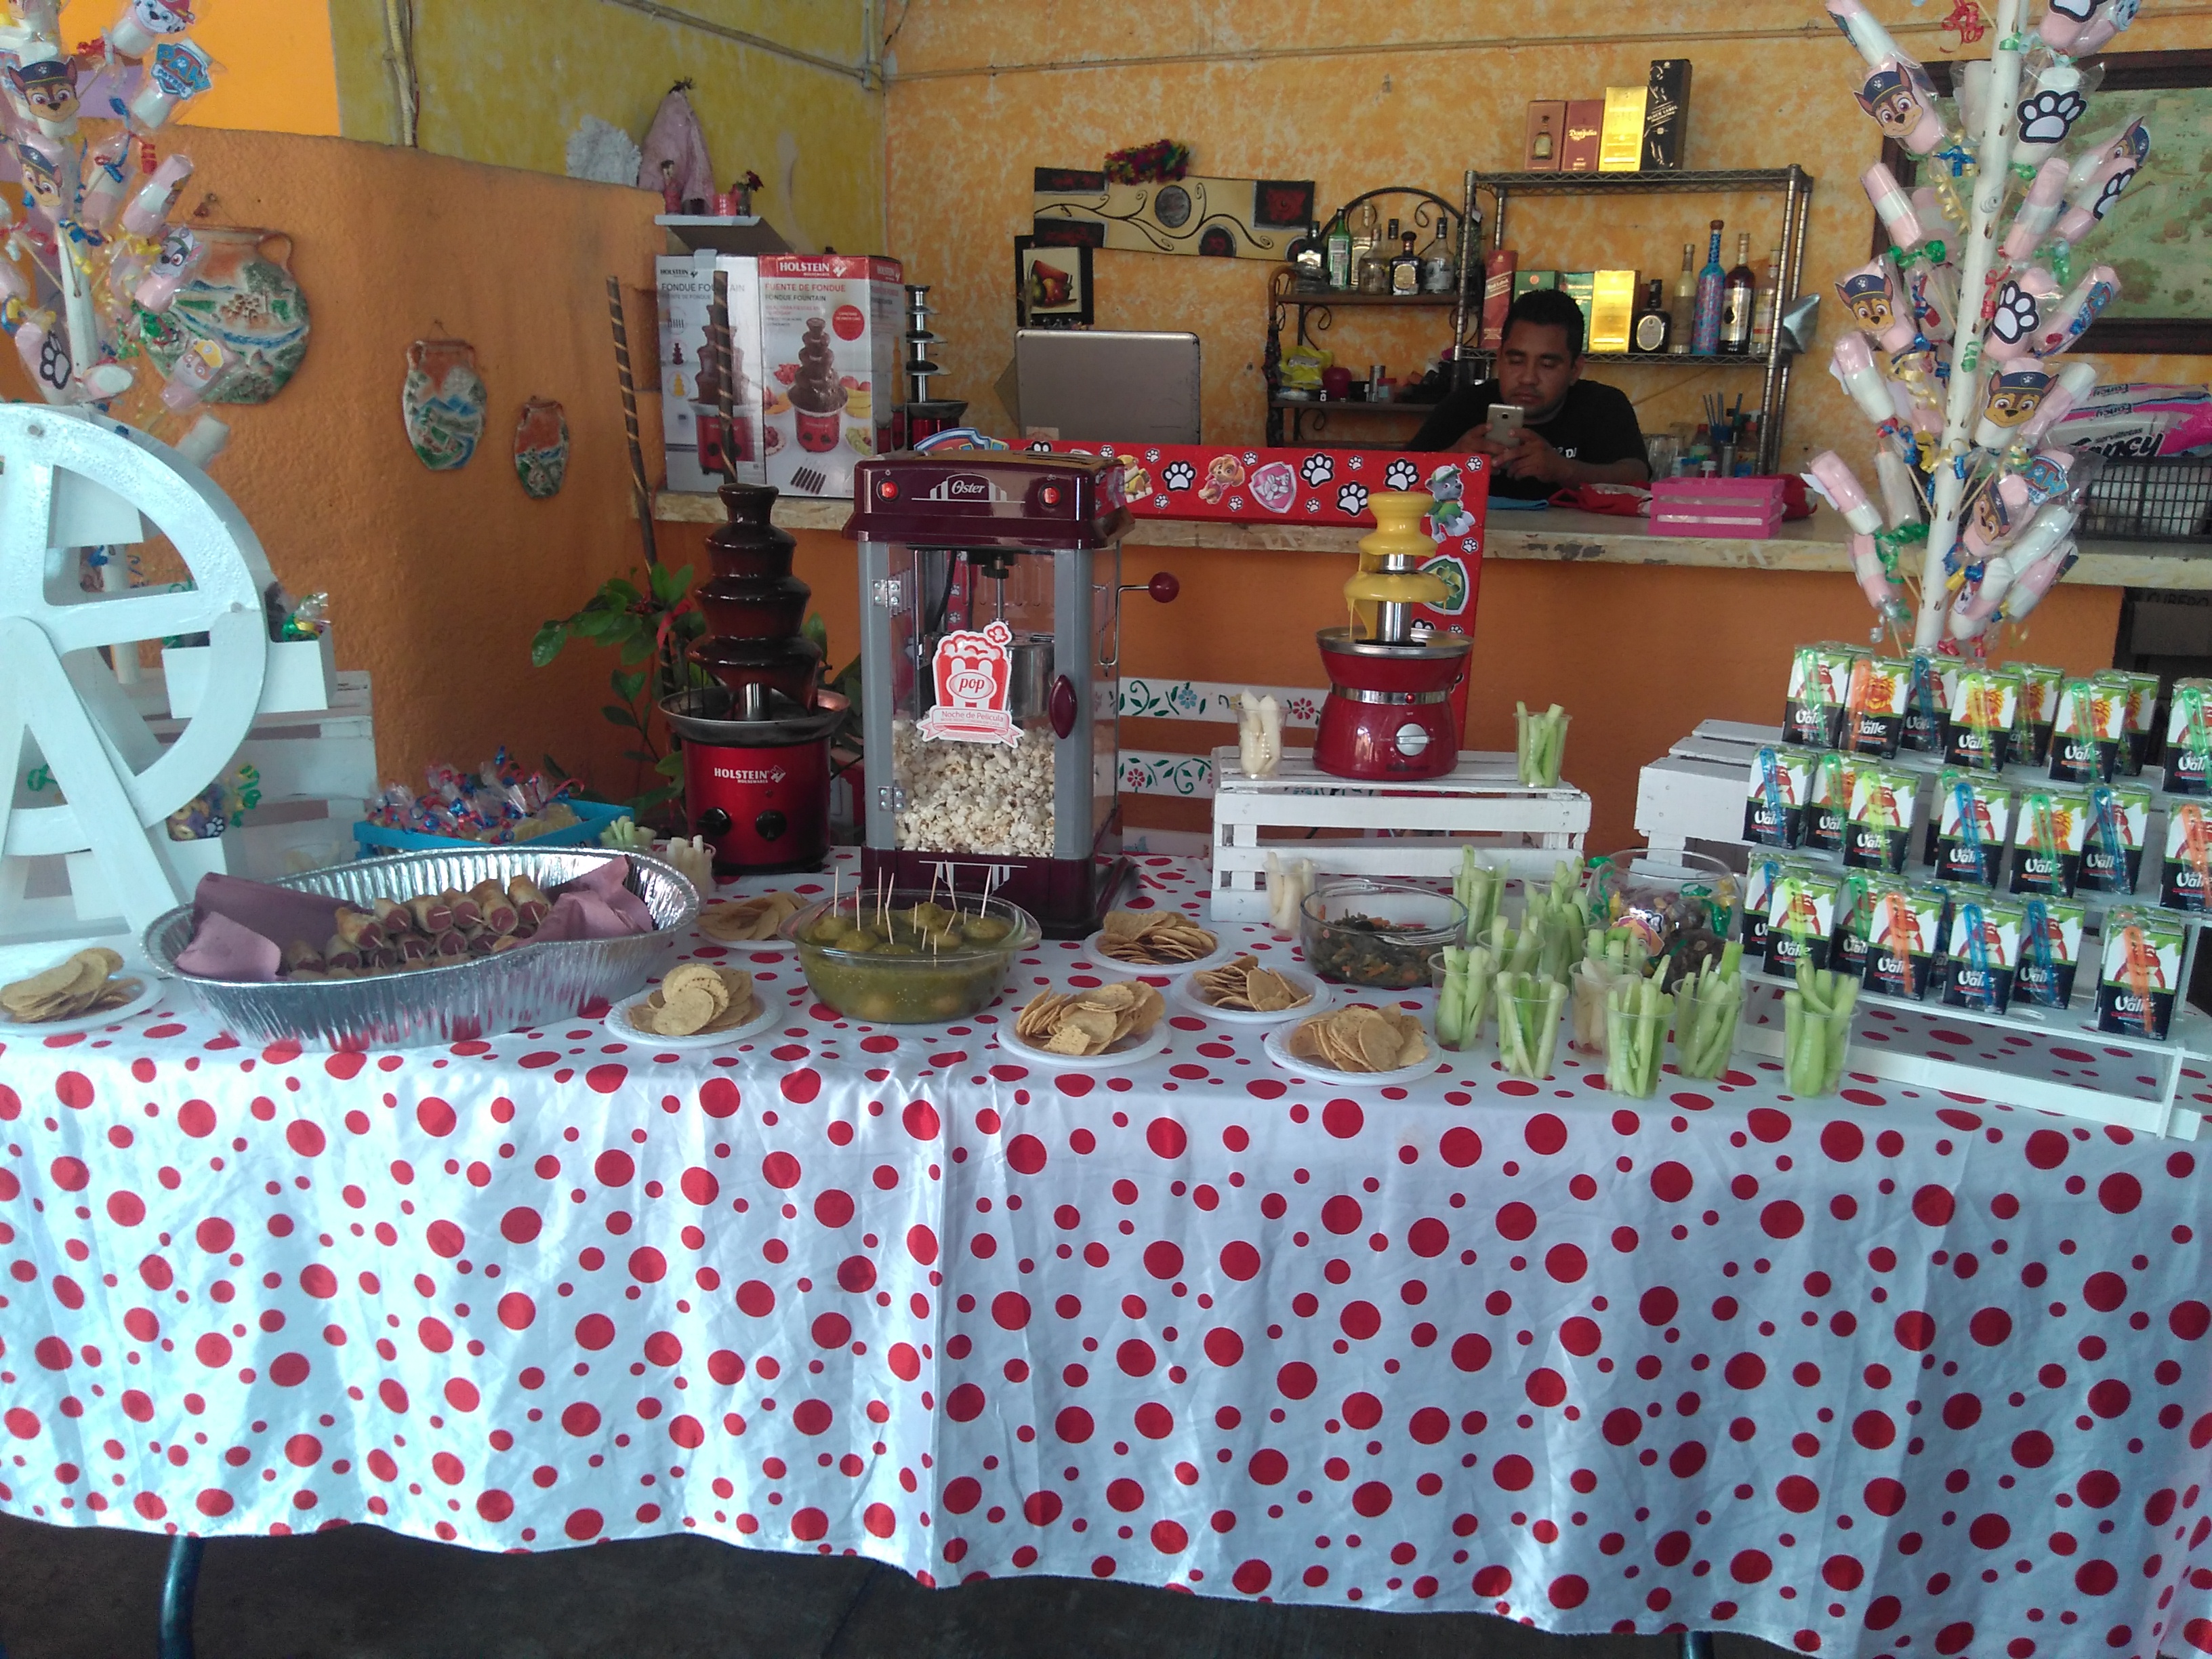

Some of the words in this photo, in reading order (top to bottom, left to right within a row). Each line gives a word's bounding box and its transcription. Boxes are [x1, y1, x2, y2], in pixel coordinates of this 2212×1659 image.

[156, 44, 211, 91] PAW
[779, 262, 830, 272] HOLSTEIN
[661, 283, 696, 291] FONDUE
[698, 283, 745, 291] FOAIN
[765, 283, 796, 291] FUENTE
[811, 284, 846, 292] FONDUE
[2093, 384, 2129, 397] Fancy
[2096, 404, 2132, 417] Fancy
[2022, 464, 2067, 495] AW
[951, 480, 985, 495] Oster
[959, 678, 984, 693] pop
[941, 710, 964, 719] Noche
[1795, 710, 1828, 724] Val
[1856, 720, 1887, 736] alle
[1906, 716, 1938, 730] Val
[2064, 745, 2102, 761] Val
[2177, 754, 2212, 772] Val
[714, 766, 767, 779] HOLSTEIN
[1755, 811, 1786, 825] Val
[1819, 815, 1843, 830] Val
[1950, 848, 1986, 864] Val
[2086, 853, 2114, 869] Vall
[2025, 858, 2064, 874] Val
[2176, 872, 2212, 888] Val
[1843, 938, 1868, 954] Vall
[1877, 958, 1915, 973] Vall
[1958, 969, 1996, 987] Val
[2020, 966, 2058, 983] Val
[2115, 995, 2156, 1012] Vall
